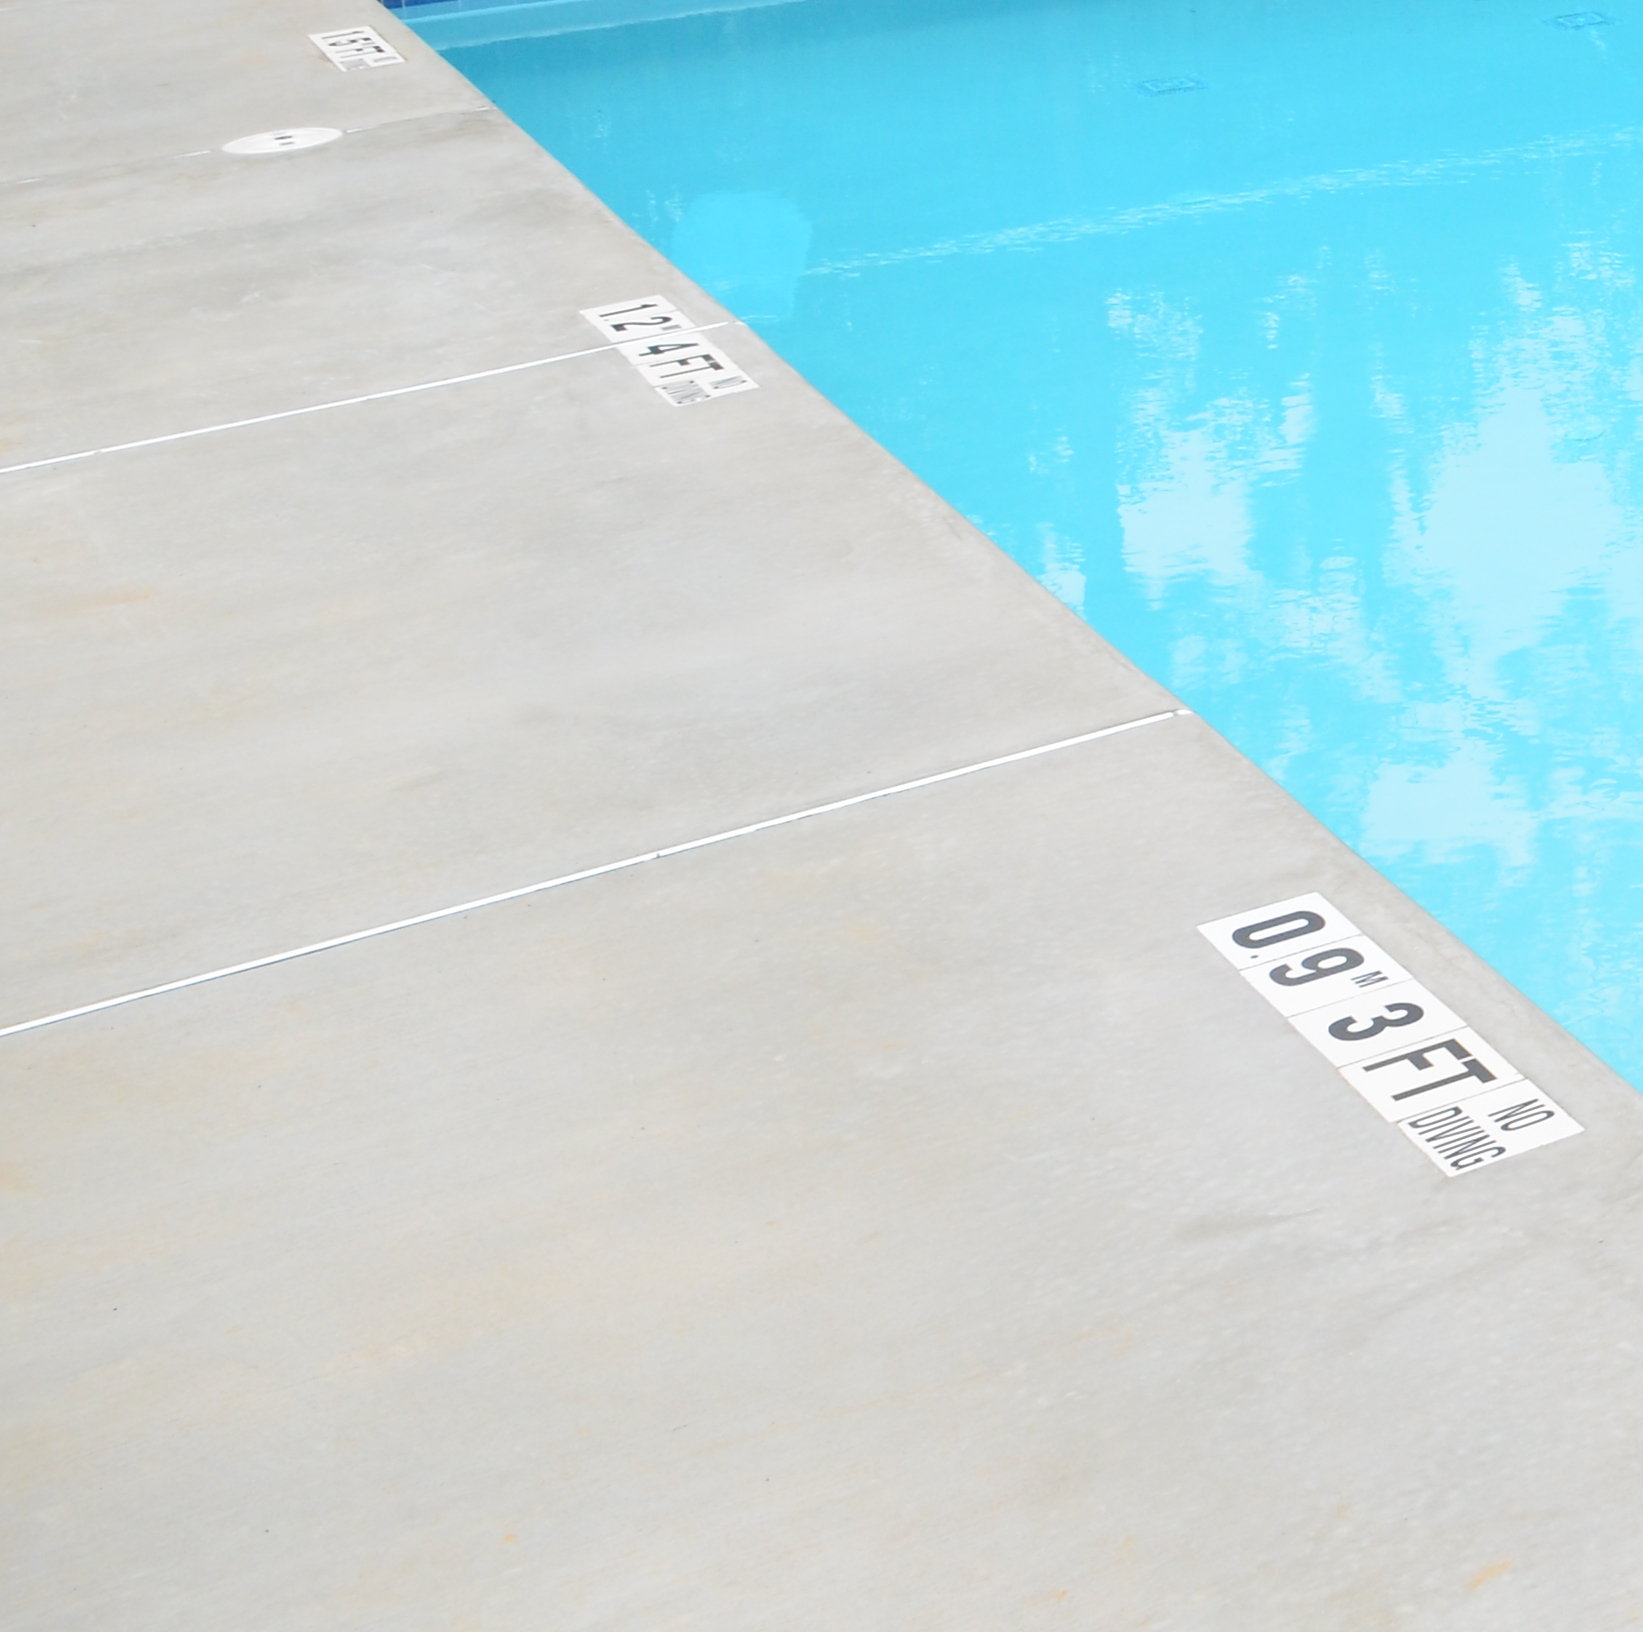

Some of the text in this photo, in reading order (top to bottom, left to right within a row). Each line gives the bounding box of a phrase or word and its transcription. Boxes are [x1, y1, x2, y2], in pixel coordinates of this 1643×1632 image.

[638, 342, 699, 356] 4
[650, 353, 724, 378] FT
[1328, 1002, 1424, 1042] 3
[1362, 1038, 1497, 1101] FT
[1488, 1098, 1555, 1132] NO
[1407, 1106, 1507, 1171] DIVING
